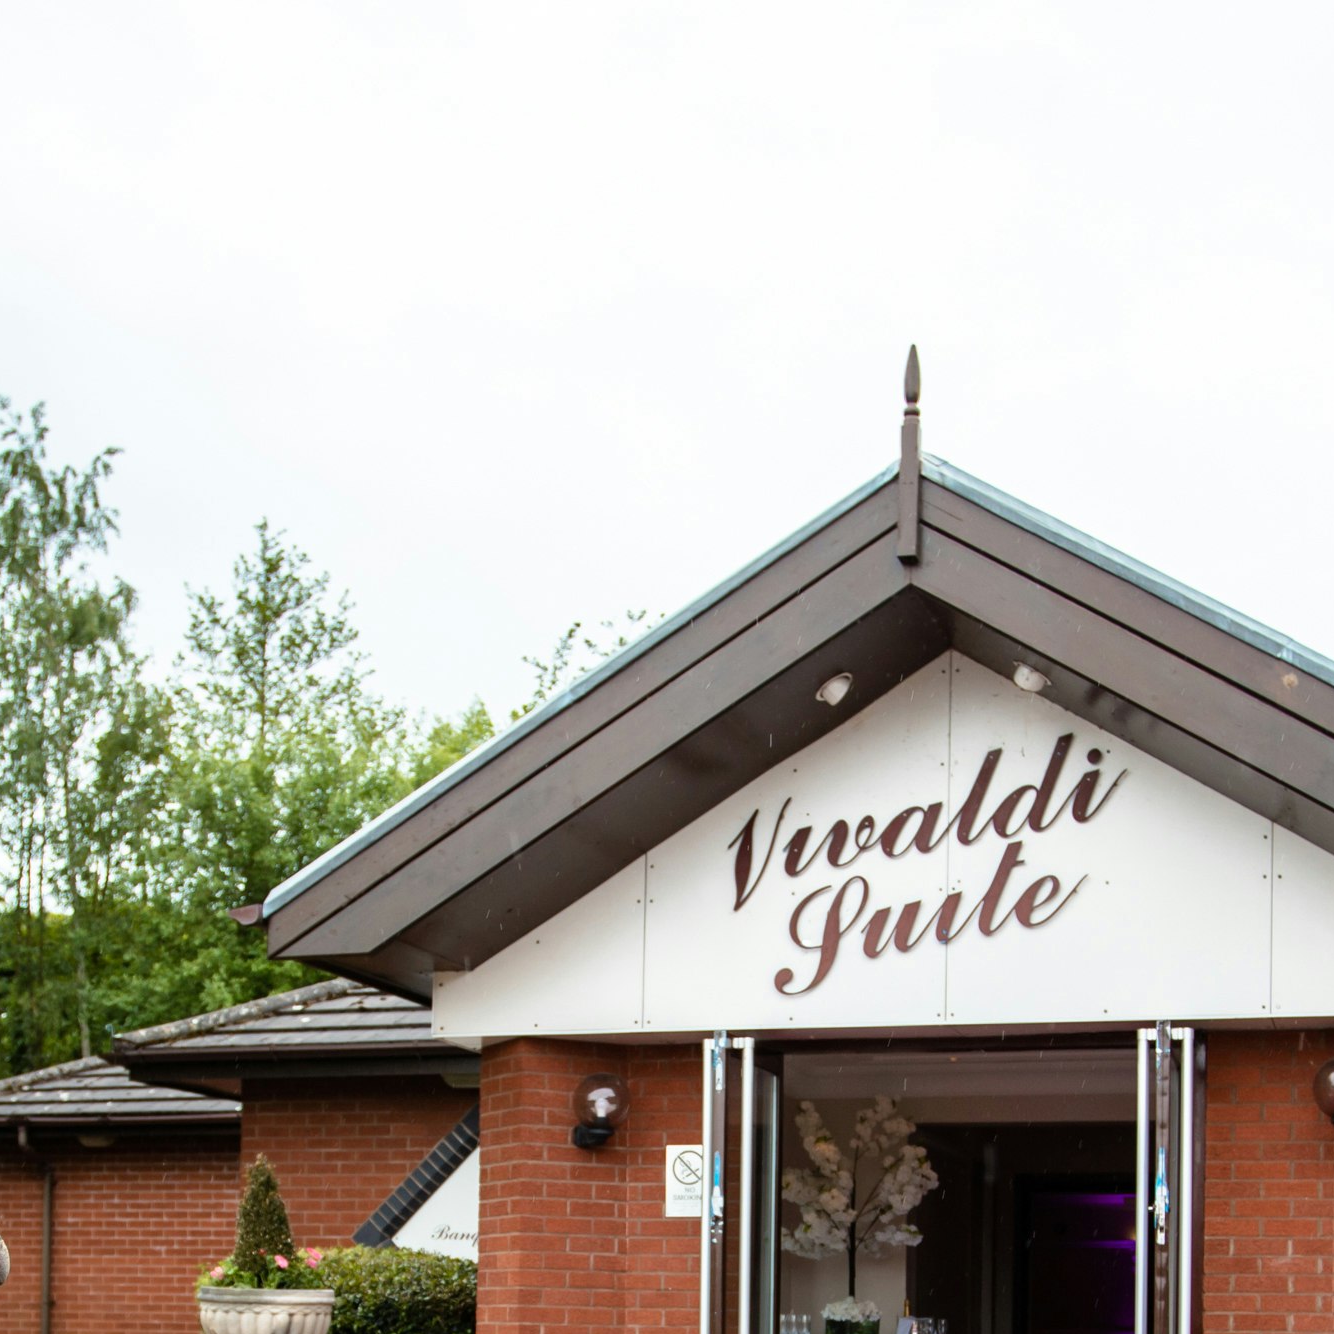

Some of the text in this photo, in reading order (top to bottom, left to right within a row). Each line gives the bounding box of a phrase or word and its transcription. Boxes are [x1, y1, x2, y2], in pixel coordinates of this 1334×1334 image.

[727, 731, 1128, 912] Vivaldi
[773, 840, 1089, 996] Suite
[431, 1224, 479, 1247] Banq
